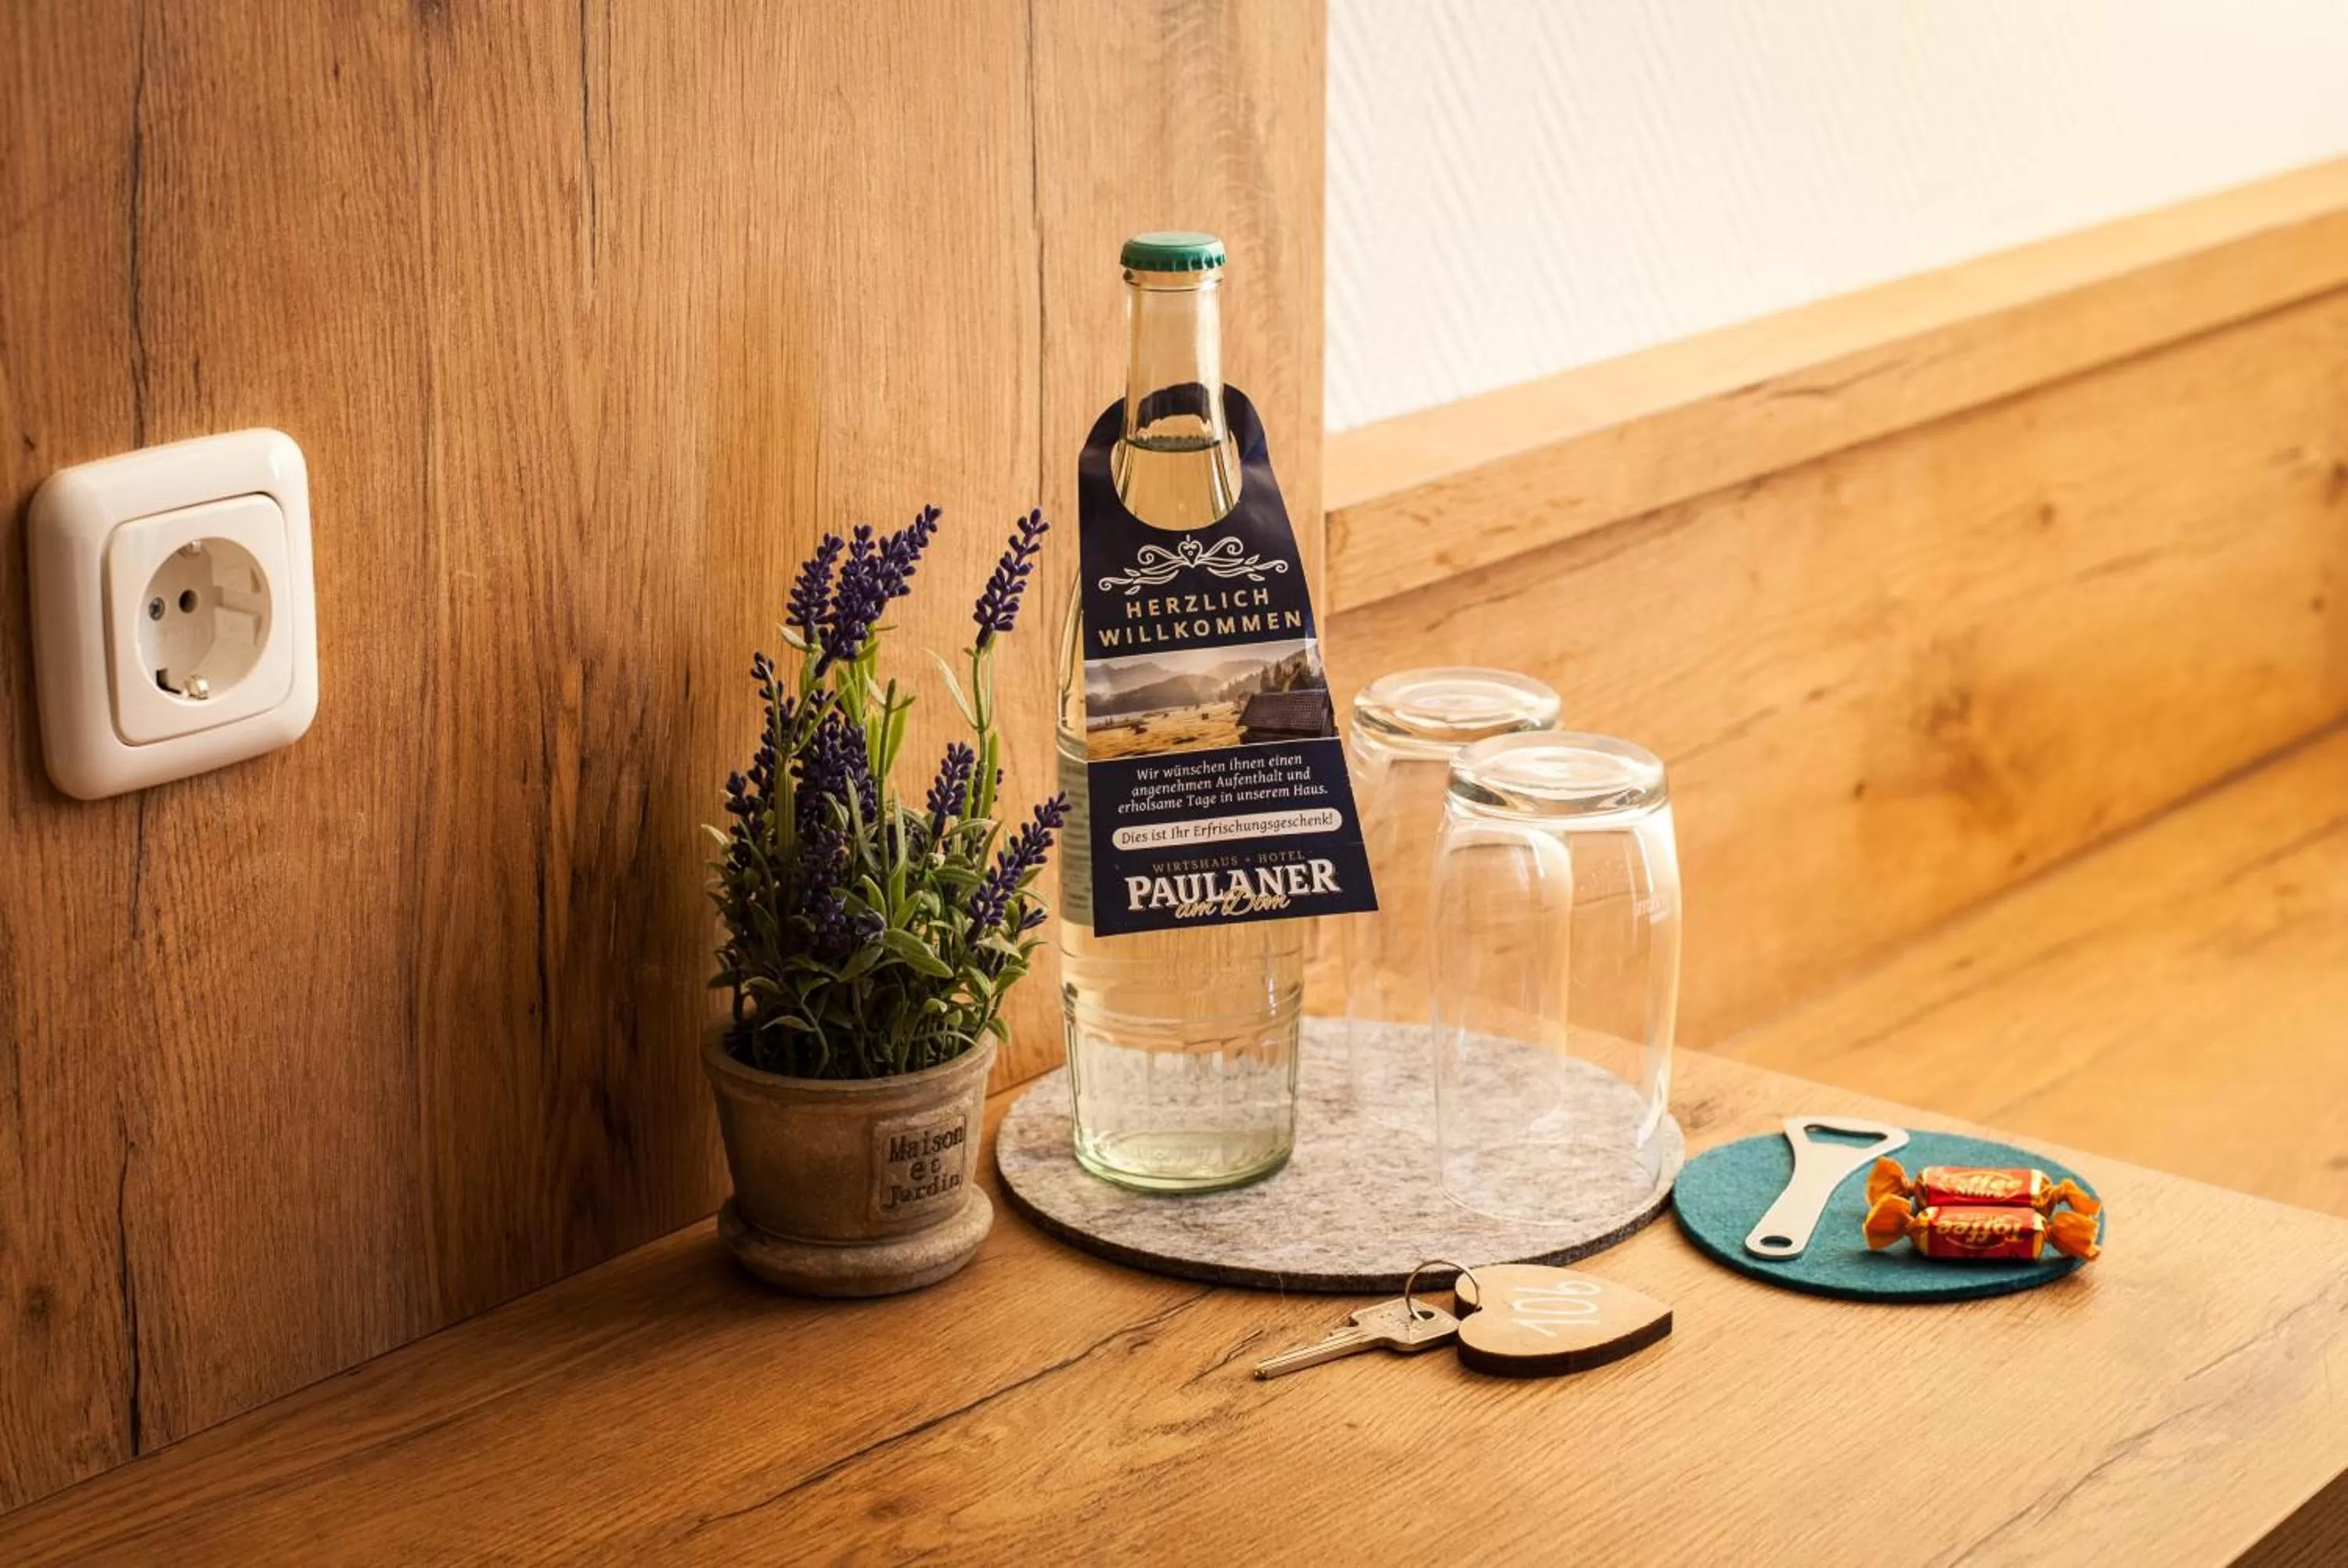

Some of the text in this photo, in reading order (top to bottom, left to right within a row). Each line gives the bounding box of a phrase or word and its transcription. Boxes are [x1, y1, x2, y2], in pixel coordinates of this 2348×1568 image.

[1126, 588, 1269, 619] HERZLICH
[1098, 610, 1302, 648] WILLKOMMEN
[1131, 766, 1311, 799] angenehmen Aufenthalt und
[1136, 768, 1159, 780] Wir
[1163, 760, 1226, 778] wünschen
[1269, 753, 1302, 768] einen
[1118, 783, 1328, 814] erholsame Tage in unserem Haus.
[1121, 811, 1334, 845] Dies ist Ihr Erfrischungsgeschenk!
[1152, 850, 1306, 874] WIRTSHAUS HOTEL
[1124, 858, 1343, 912] PAULANER
[888, 1126, 963, 1163] Maison
[1511, 1280, 1603, 1339] 106
